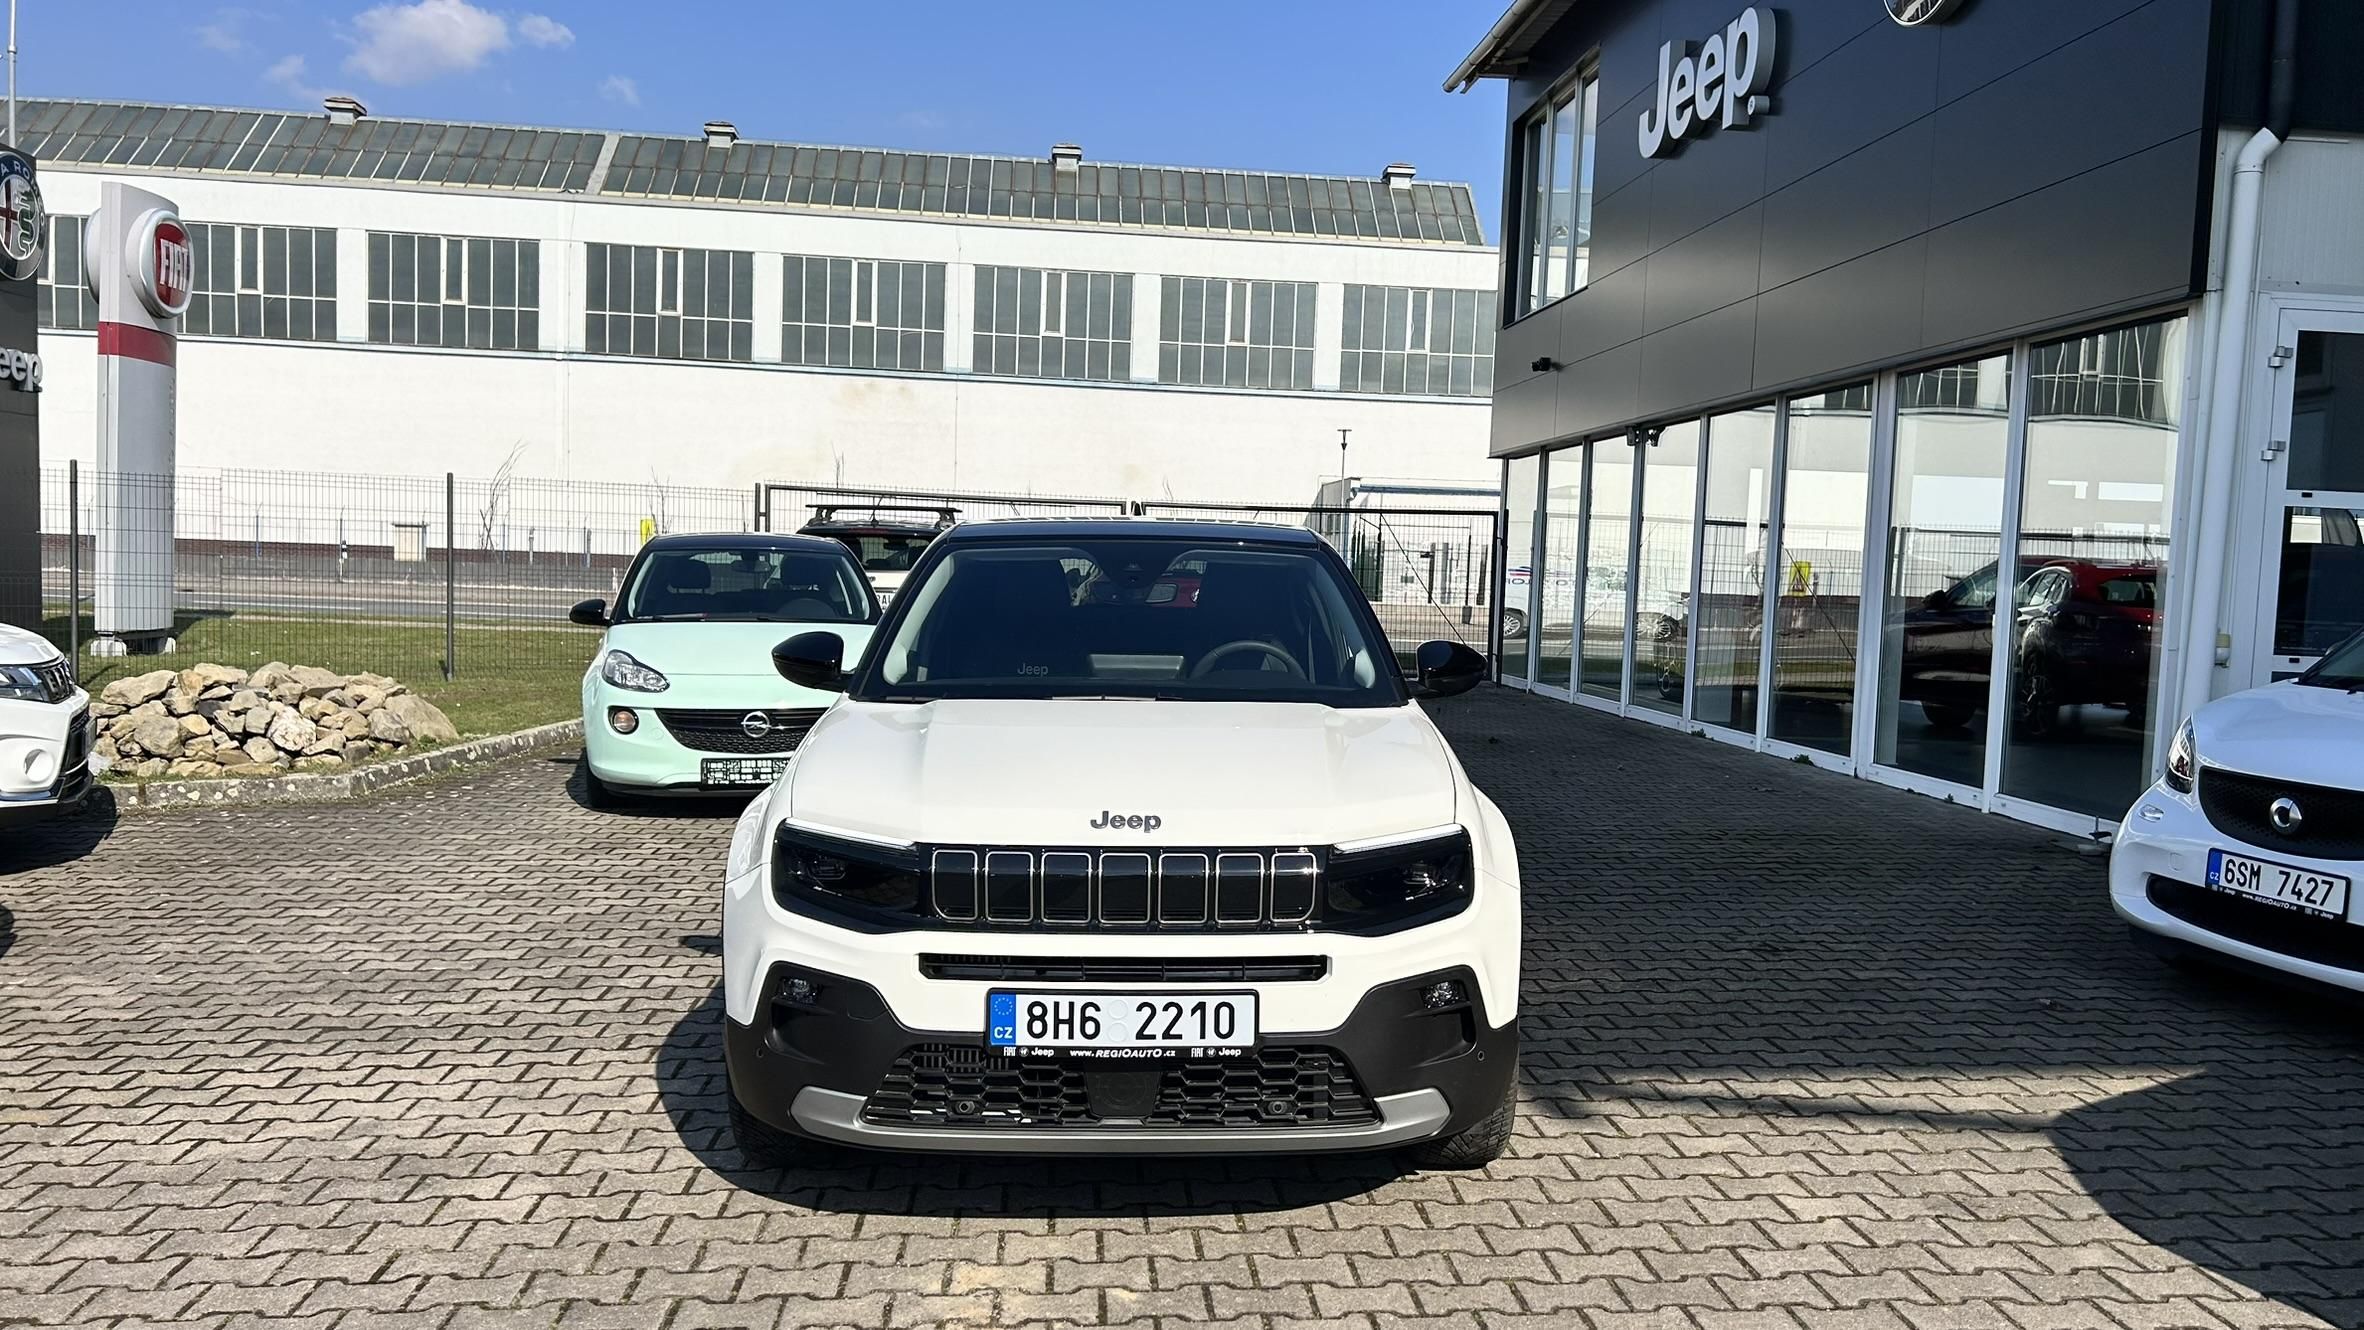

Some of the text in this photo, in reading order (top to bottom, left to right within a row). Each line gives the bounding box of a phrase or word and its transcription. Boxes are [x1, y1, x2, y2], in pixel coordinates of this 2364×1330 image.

[1638, 7, 1761, 159] Jeep
[159, 238, 189, 293] FIAT
[0, 347, 43, 392] eep
[1017, 662, 1049, 678] Jeep
[1090, 810, 1161, 833] Jeep
[2209, 858, 2335, 906] CZ 6SM 7427
[994, 1000, 1236, 1040] CZ 8H6 2210
[1003, 1047, 1017, 1056] FIAT
[1031, 1047, 1055, 1058] Jeep
[1191, 1048, 1204, 1058] FIAT
[1218, 1048, 1242, 1057] Jeep
